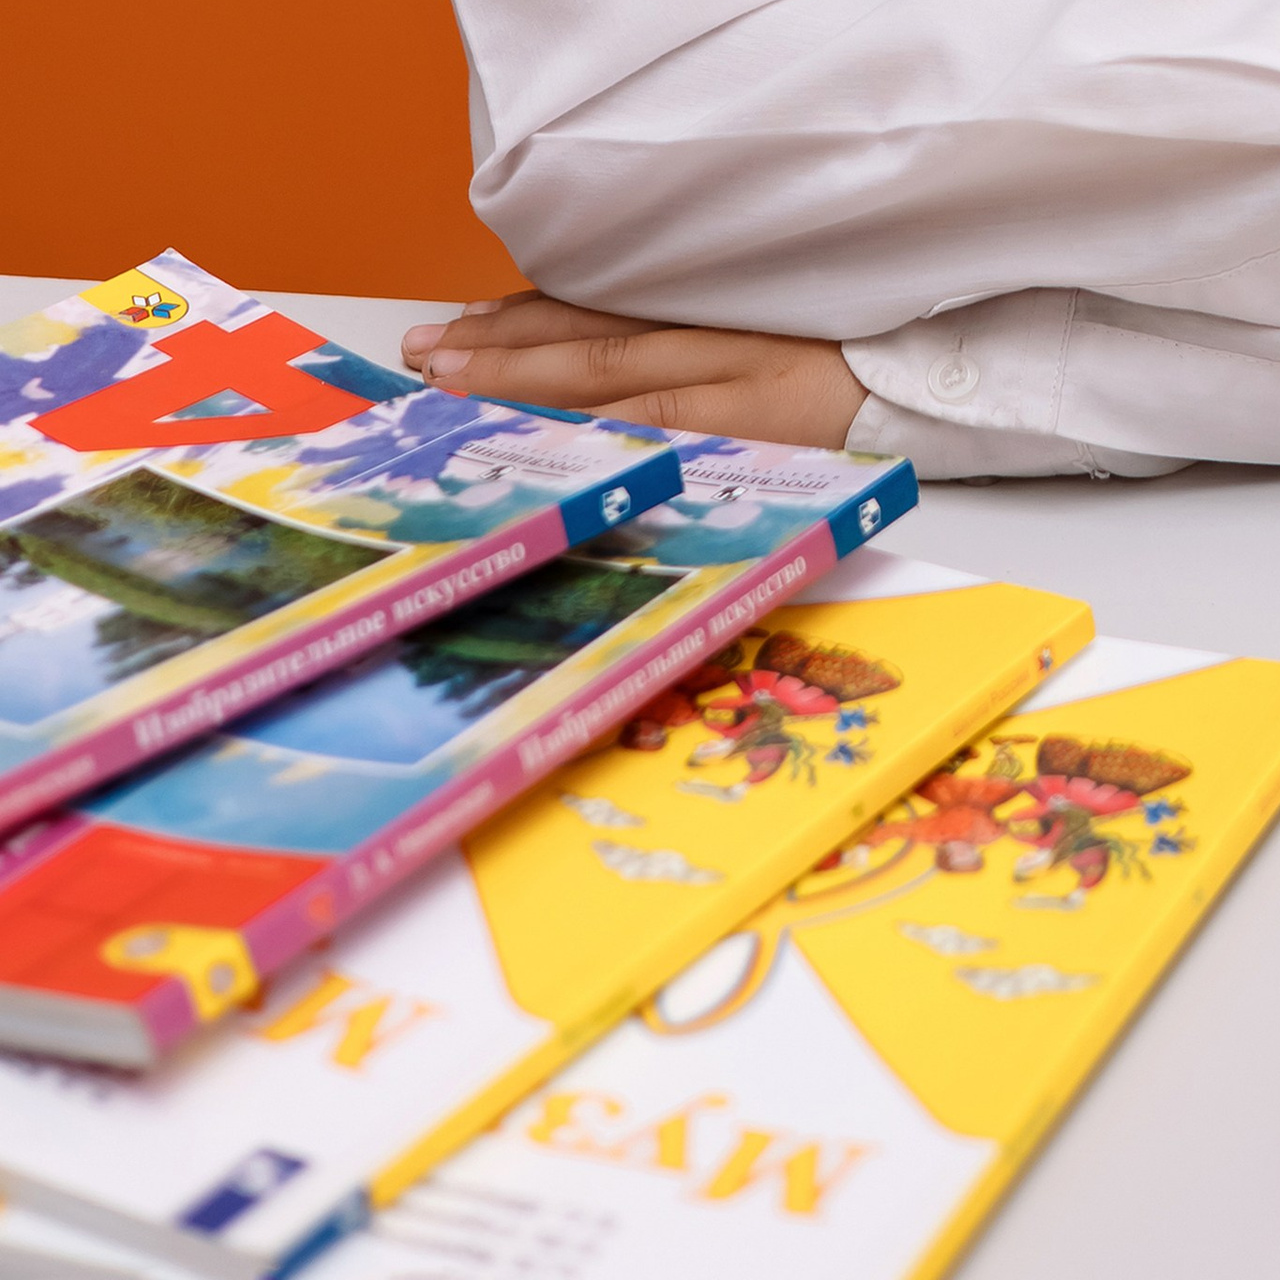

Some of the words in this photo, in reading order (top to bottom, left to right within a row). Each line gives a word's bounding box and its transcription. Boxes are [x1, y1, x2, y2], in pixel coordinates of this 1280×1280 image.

[26, 310, 378, 453] 4
[461, 442, 590, 473] ПРОСВЕЩЕНИЕ
[681, 465, 830, 490] ПРОСВЕЩЕНИ
[132, 609, 386, 750] Изобразительное
[392, 541, 527, 620] искусство
[707, 555, 808, 635] искусство
[524, 1090, 874, 1217] Муз
